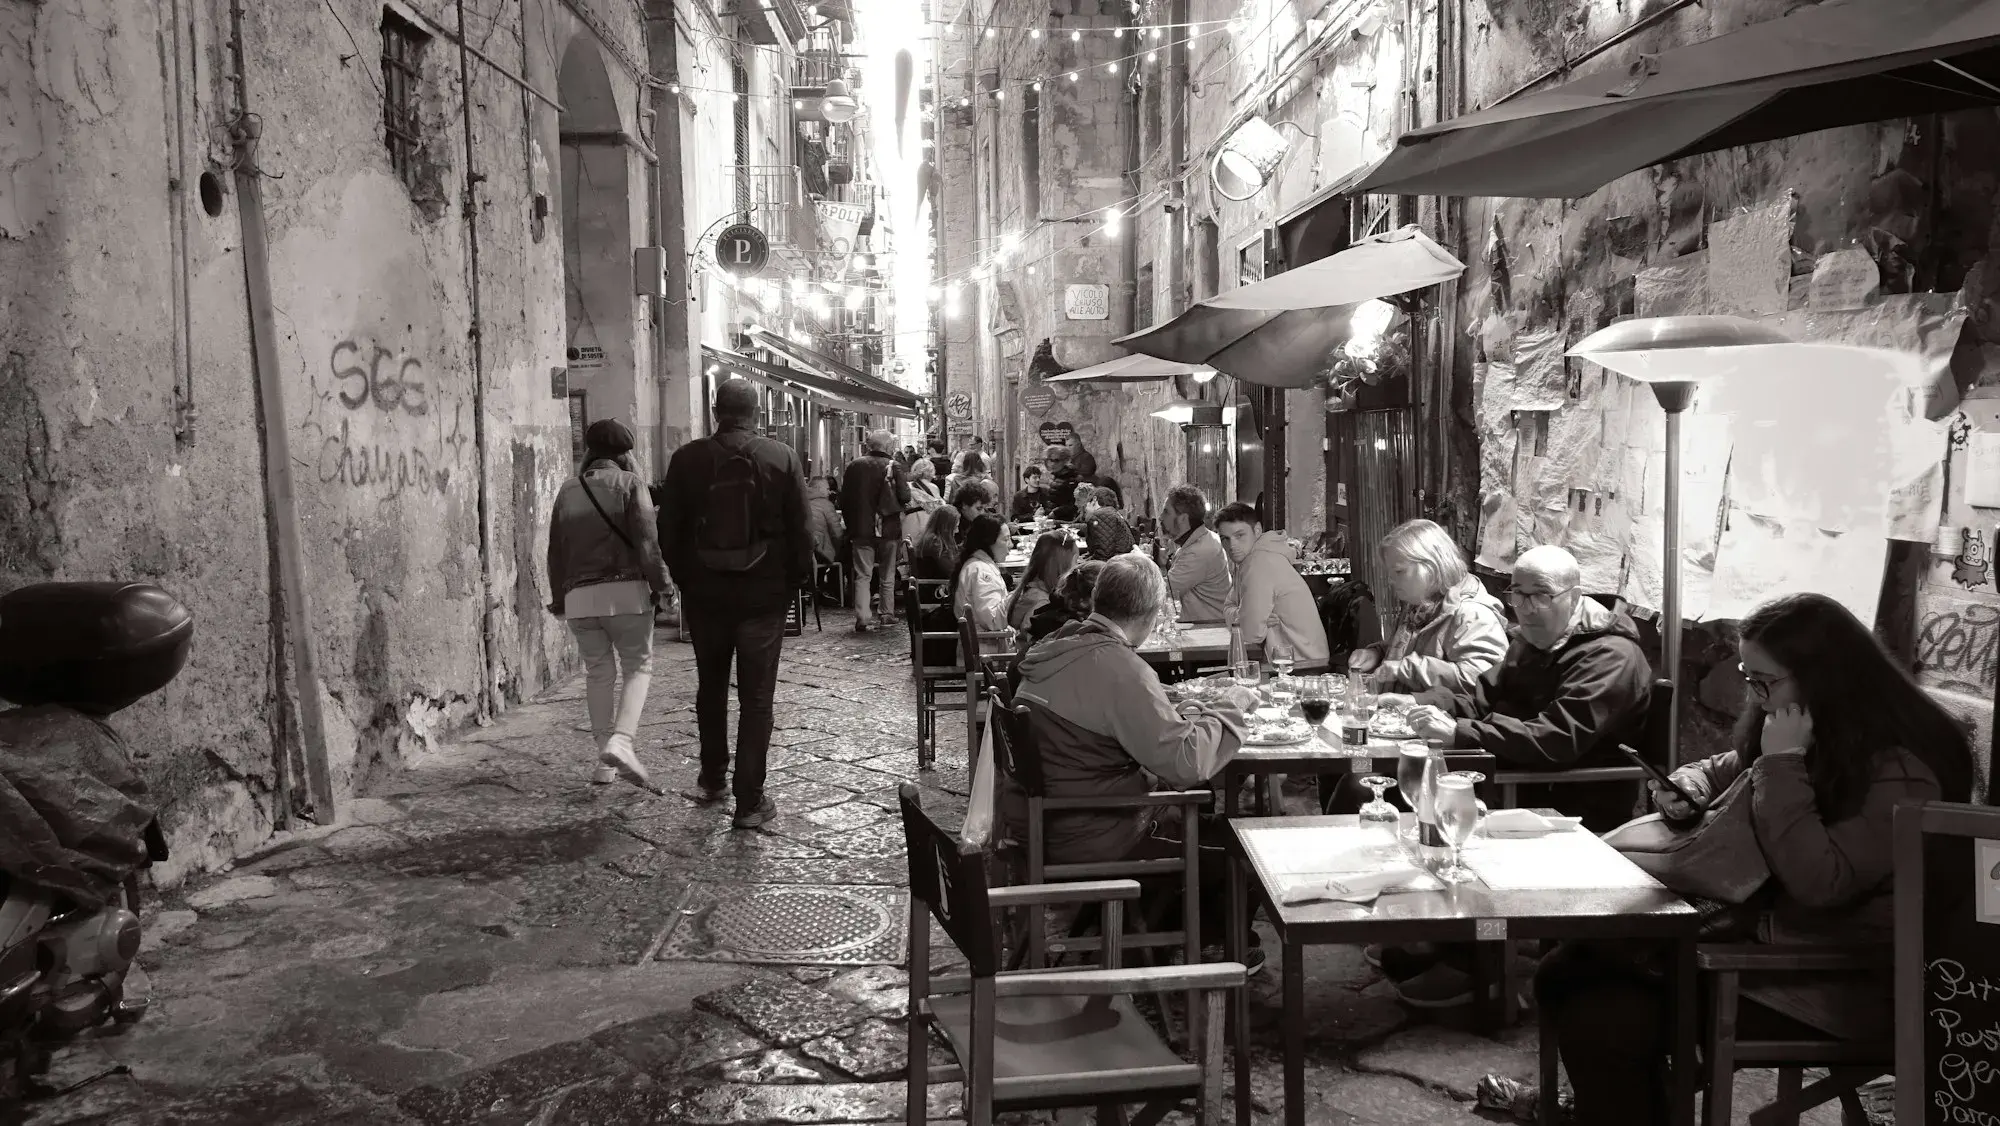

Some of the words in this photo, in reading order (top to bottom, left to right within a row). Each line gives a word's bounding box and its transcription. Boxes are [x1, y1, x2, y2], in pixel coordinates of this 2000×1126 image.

[1071, 289, 1104, 299] VICOLO
[1085, 307, 1105, 315] AUTO
[1483, 922, 1501, 936] 21
